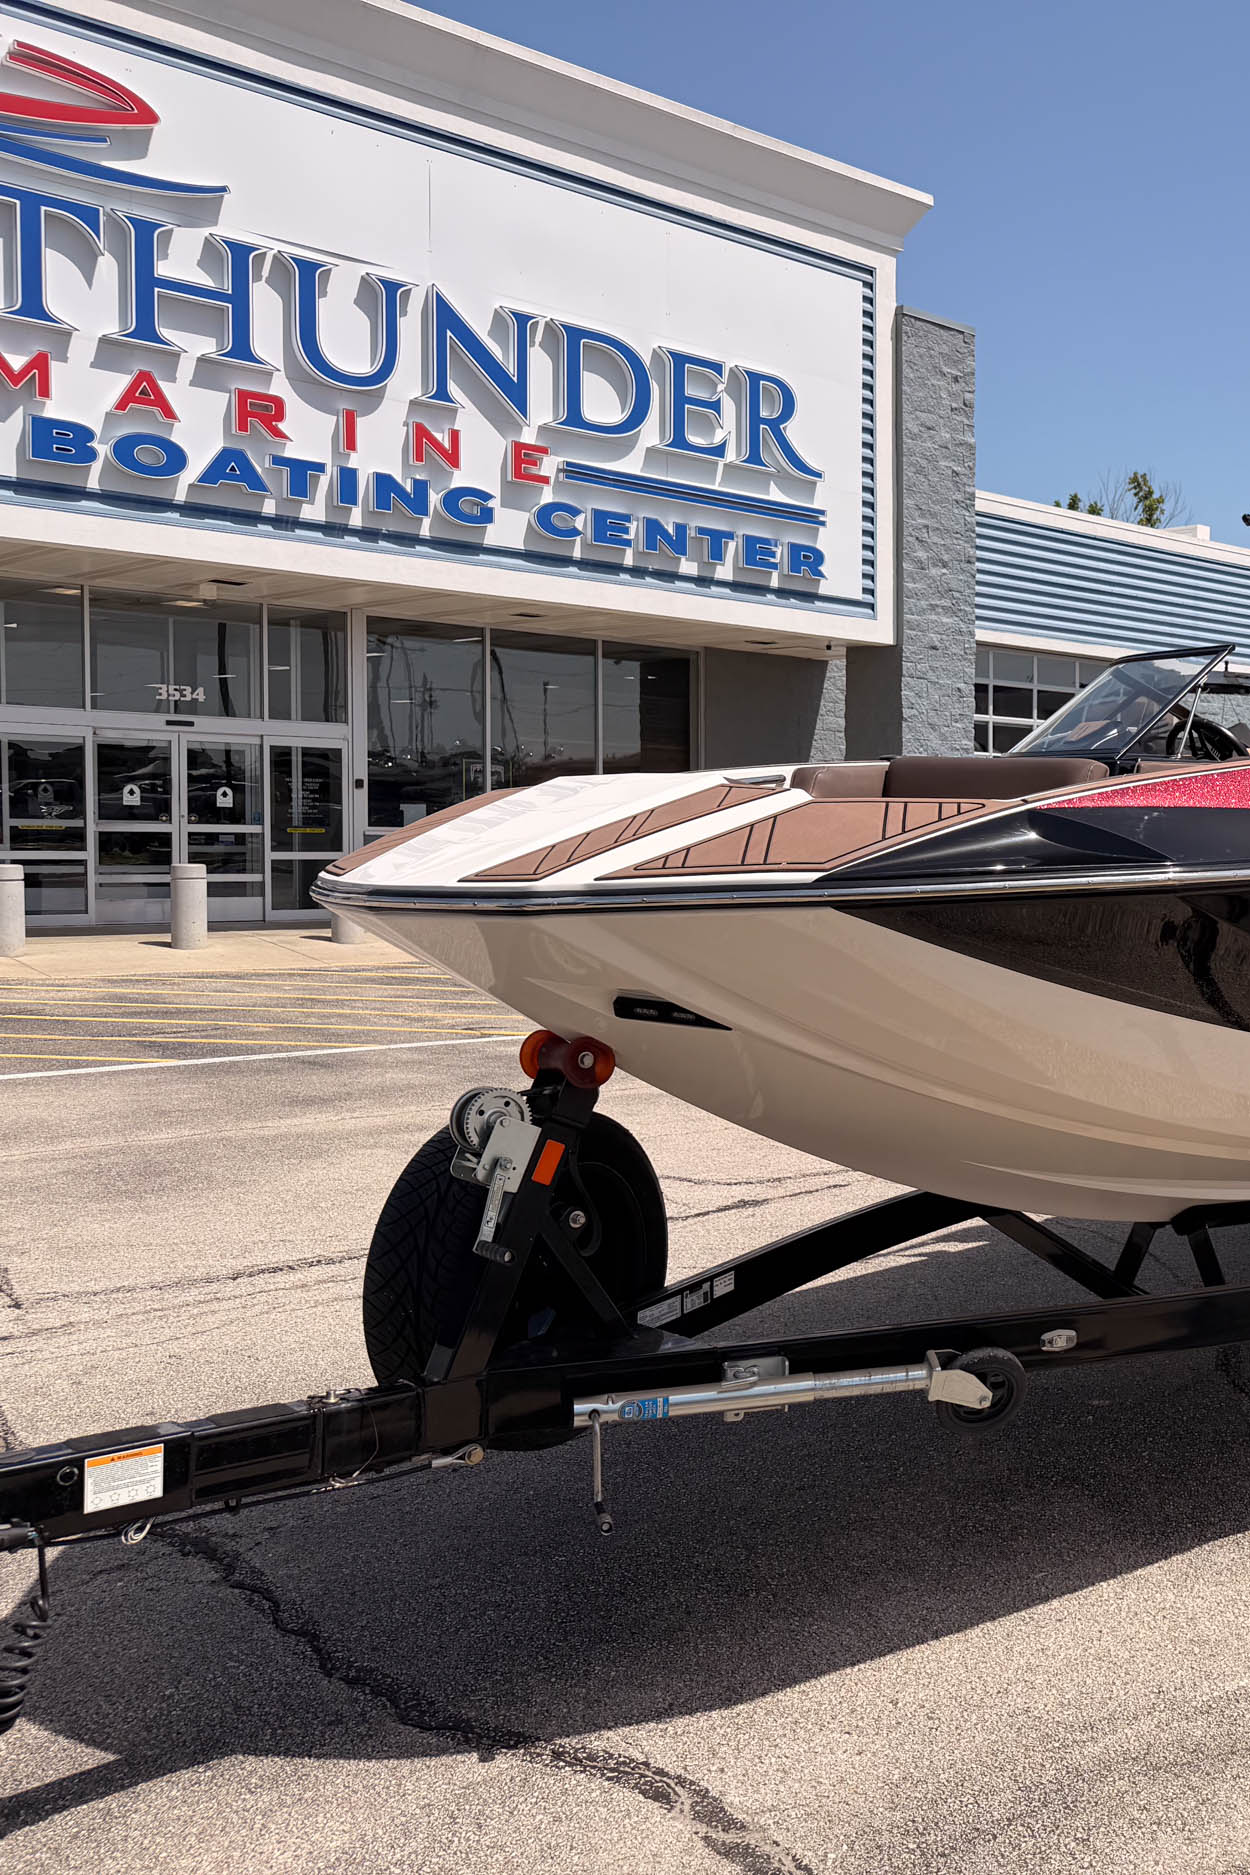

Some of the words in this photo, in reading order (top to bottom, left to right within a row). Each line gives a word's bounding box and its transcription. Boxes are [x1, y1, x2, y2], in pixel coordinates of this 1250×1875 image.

[0, 182, 823, 480] THUNDER
[28, 414, 496, 527] BOATING
[531, 501, 827, 580] CENTER
[155, 684, 206, 702] 3534
